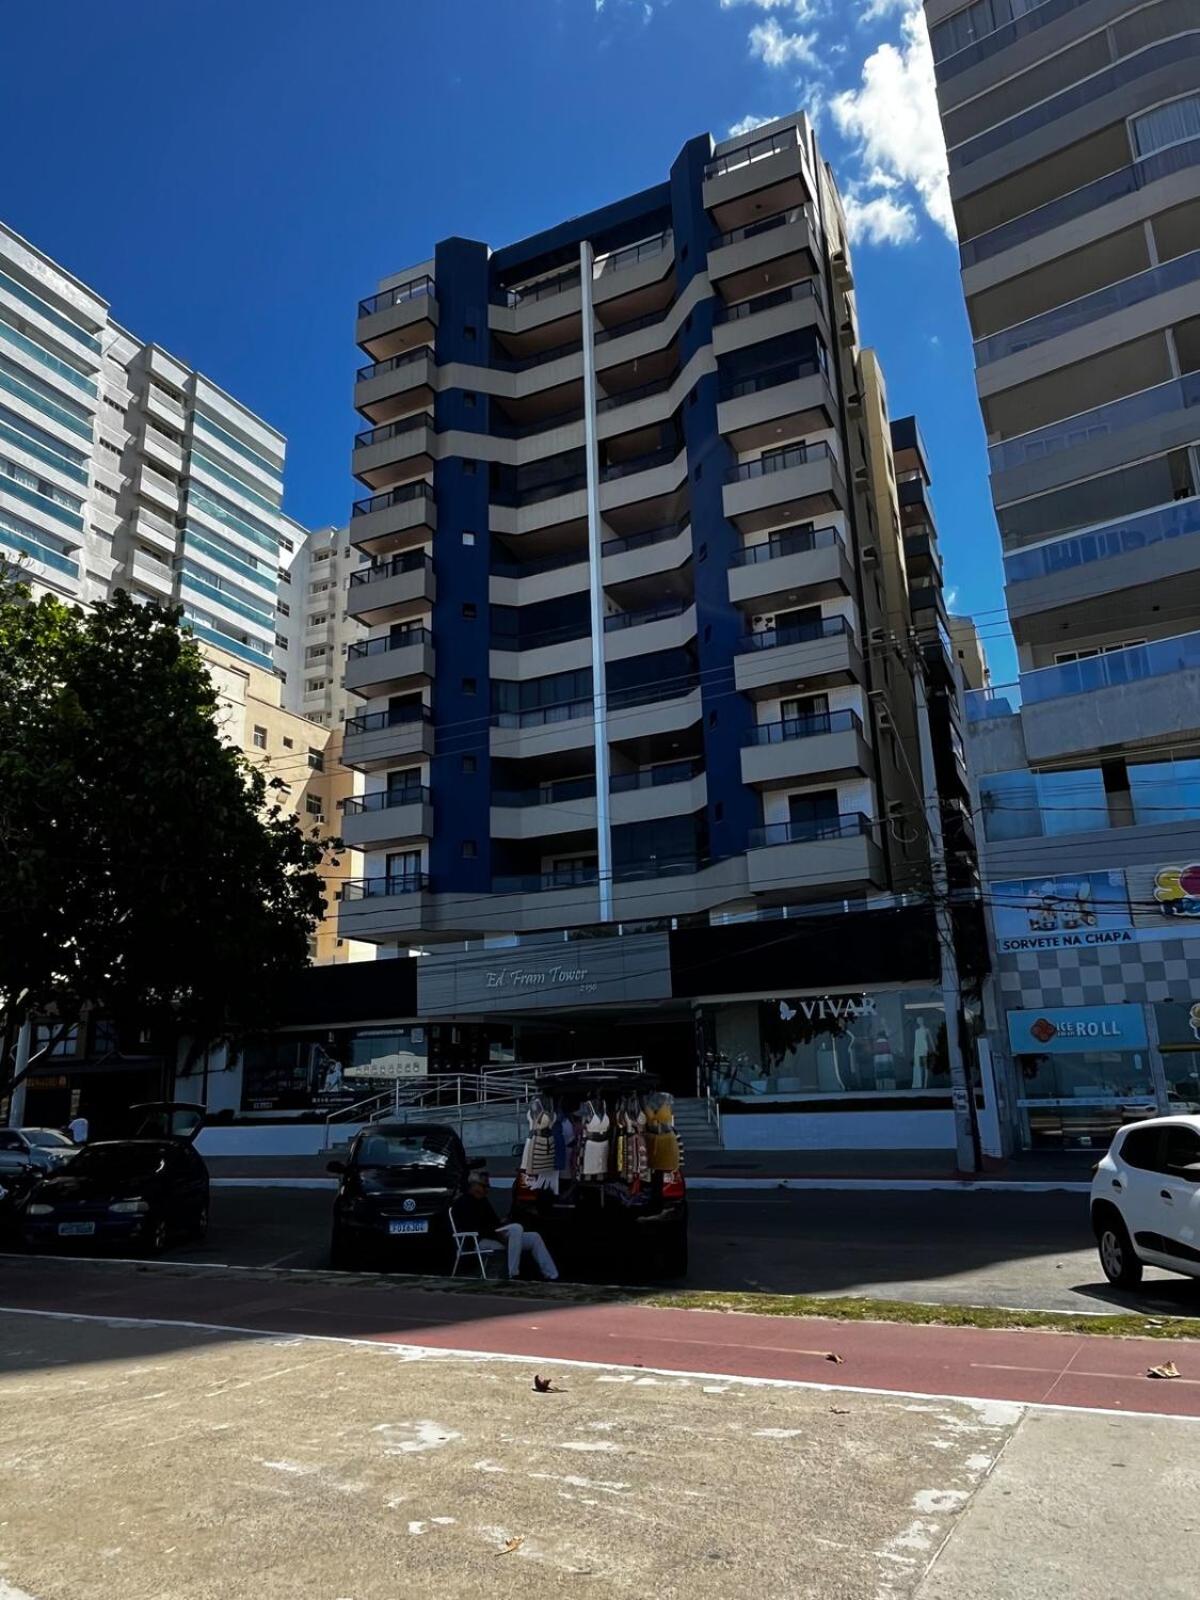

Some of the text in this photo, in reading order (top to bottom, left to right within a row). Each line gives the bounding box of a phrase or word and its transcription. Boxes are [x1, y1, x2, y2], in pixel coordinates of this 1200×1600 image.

[1003, 931, 1132, 951] SORVETE NA CHAPA
[510, 969, 545, 987] Fram
[549, 966, 588, 984] Tower
[800, 997, 878, 1020] VIVAR
[1056, 1022, 1073, 1031] ICE
[1076, 1020, 1121, 1036] ROLL
